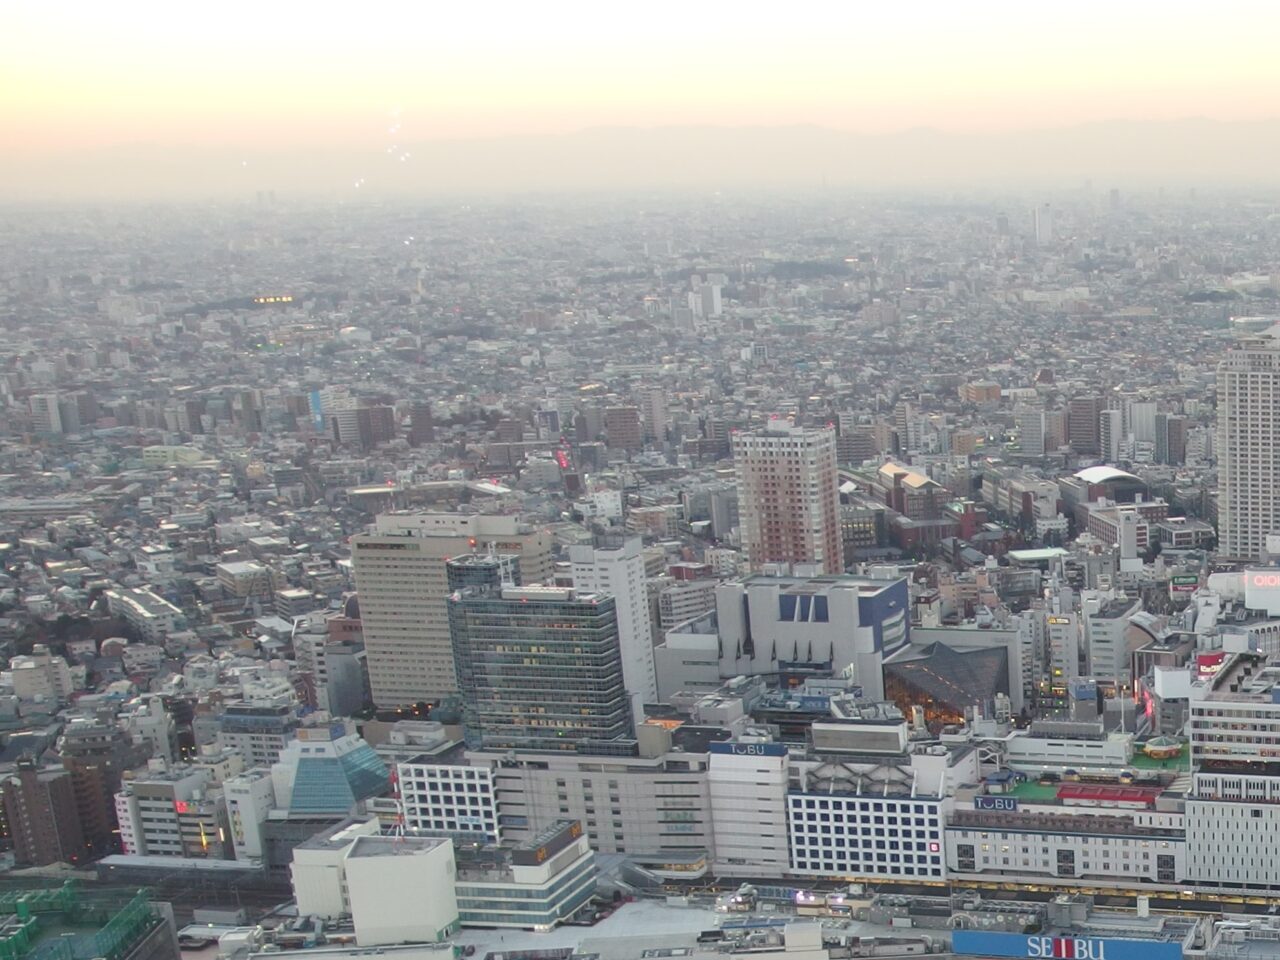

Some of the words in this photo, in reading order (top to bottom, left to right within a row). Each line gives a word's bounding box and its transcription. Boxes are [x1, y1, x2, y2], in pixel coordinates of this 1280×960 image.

[730, 744, 765, 755] TOBU
[975, 797, 1014, 810] TOBU
[1027, 936, 1105, 960] SEIBU
